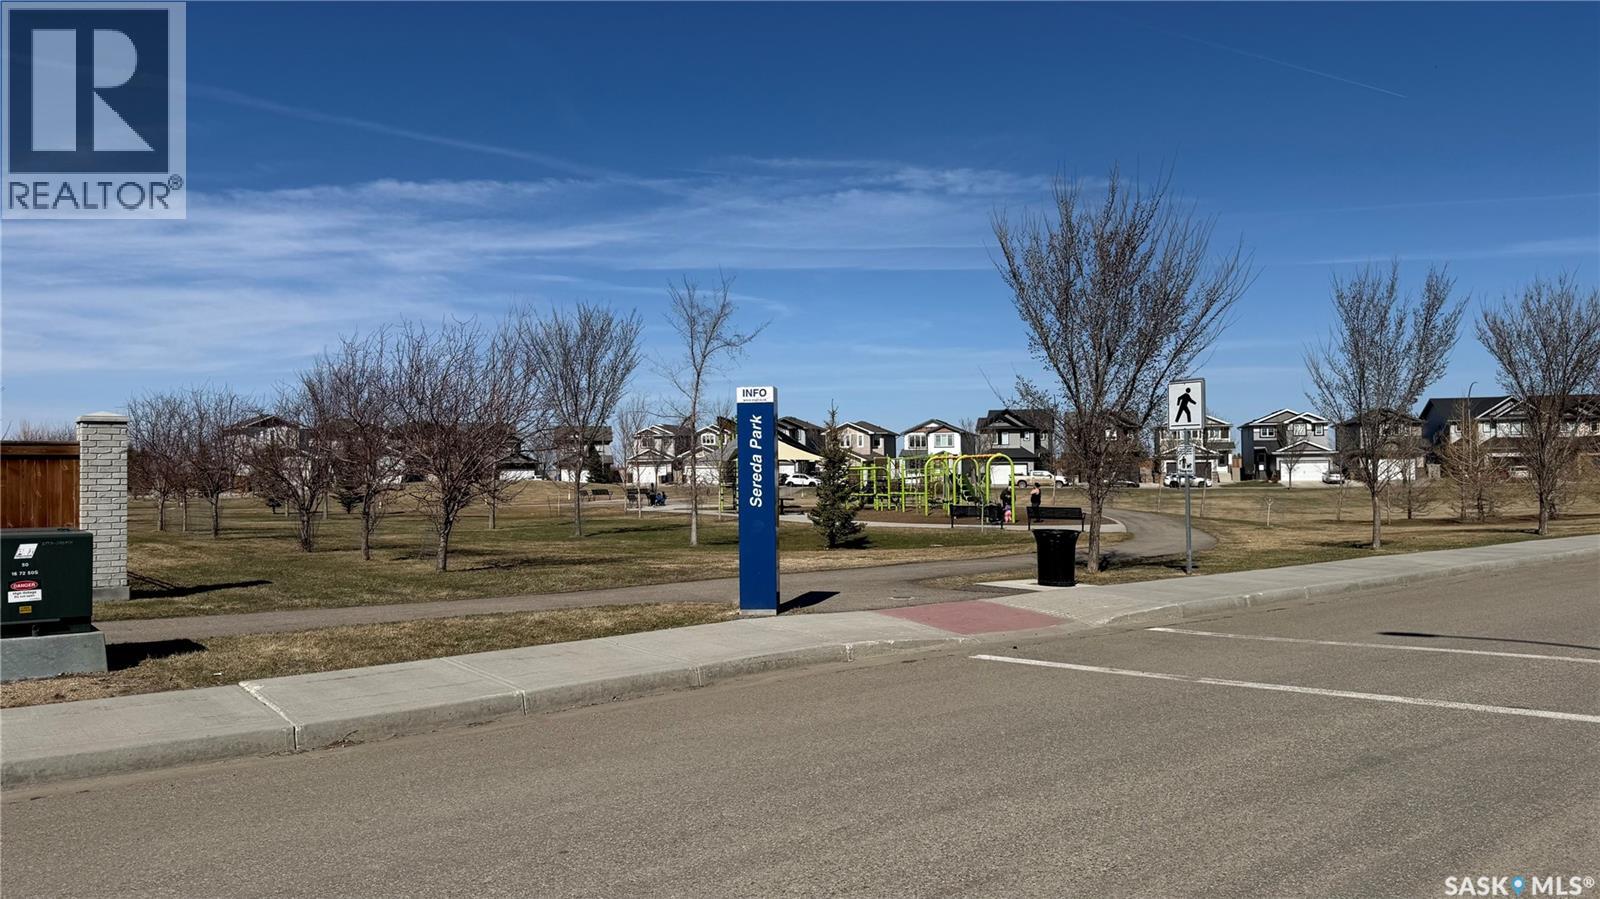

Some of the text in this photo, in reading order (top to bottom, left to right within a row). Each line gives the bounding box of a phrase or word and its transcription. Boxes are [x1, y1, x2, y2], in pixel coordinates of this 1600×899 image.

[742, 388, 767, 397] INFO
[750, 414, 762, 449] Park
[750, 454, 762, 507] Sereda
